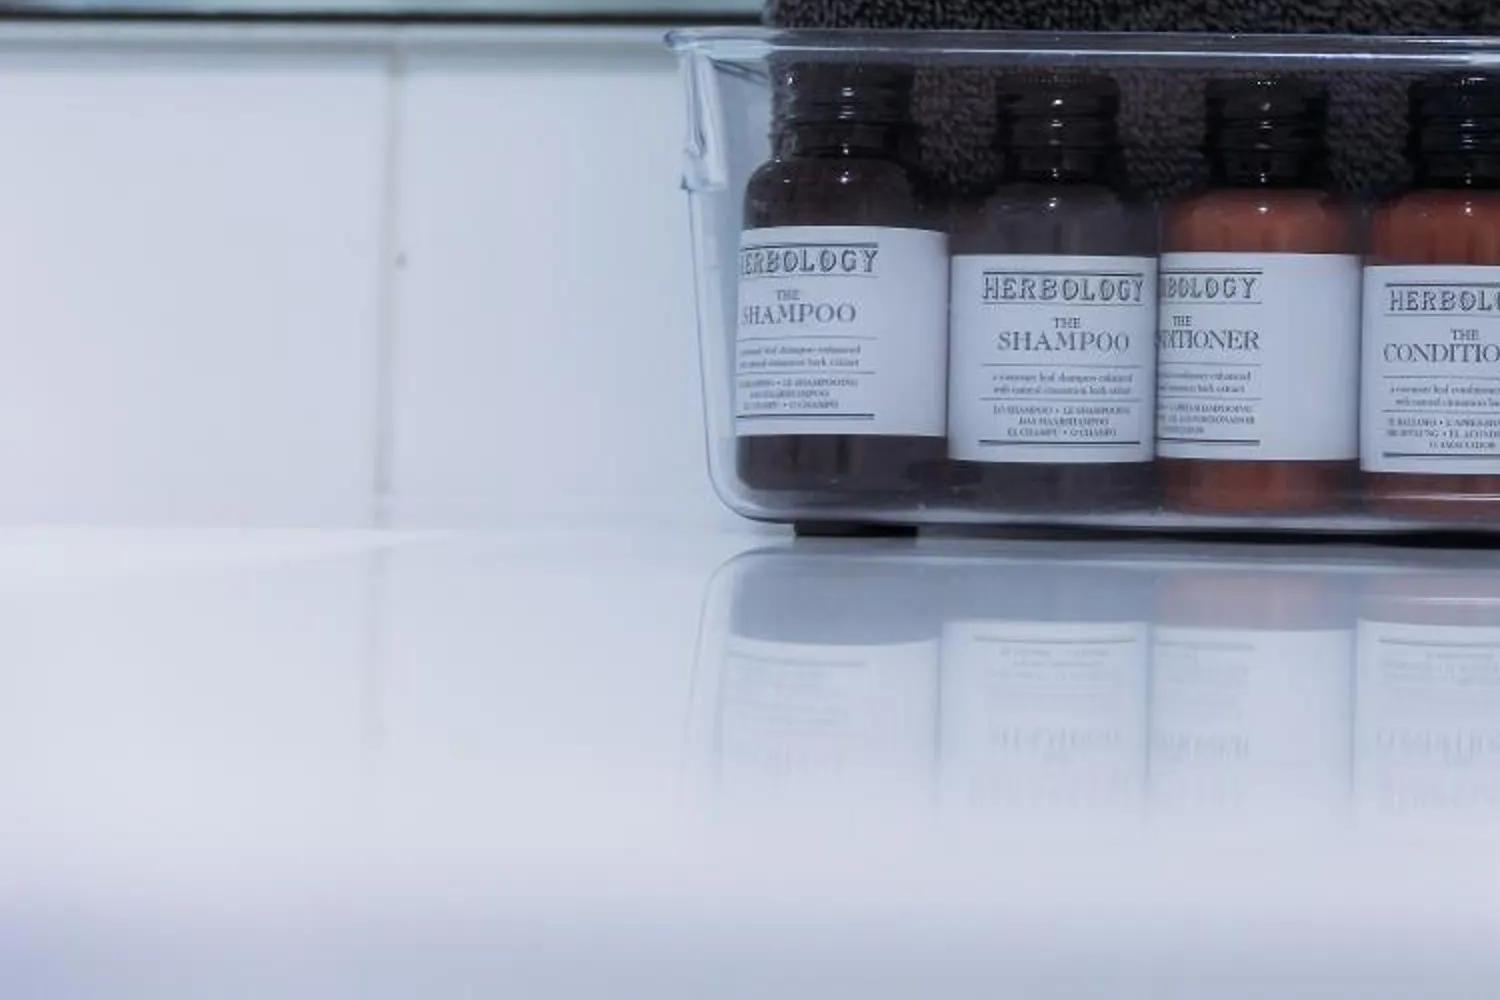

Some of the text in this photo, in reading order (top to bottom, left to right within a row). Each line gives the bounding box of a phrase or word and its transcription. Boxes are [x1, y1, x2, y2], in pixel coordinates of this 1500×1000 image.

[775, 288, 800, 301] THE
[983, 277, 1144, 301] HERBOLOGY
[742, 303, 856, 325] SHAMPOO
[1054, 317, 1081, 329] THE
[1172, 315, 1192, 327] THE
[997, 331, 1130, 351] SHAMPOO
[1451, 329, 1480, 341] THE
